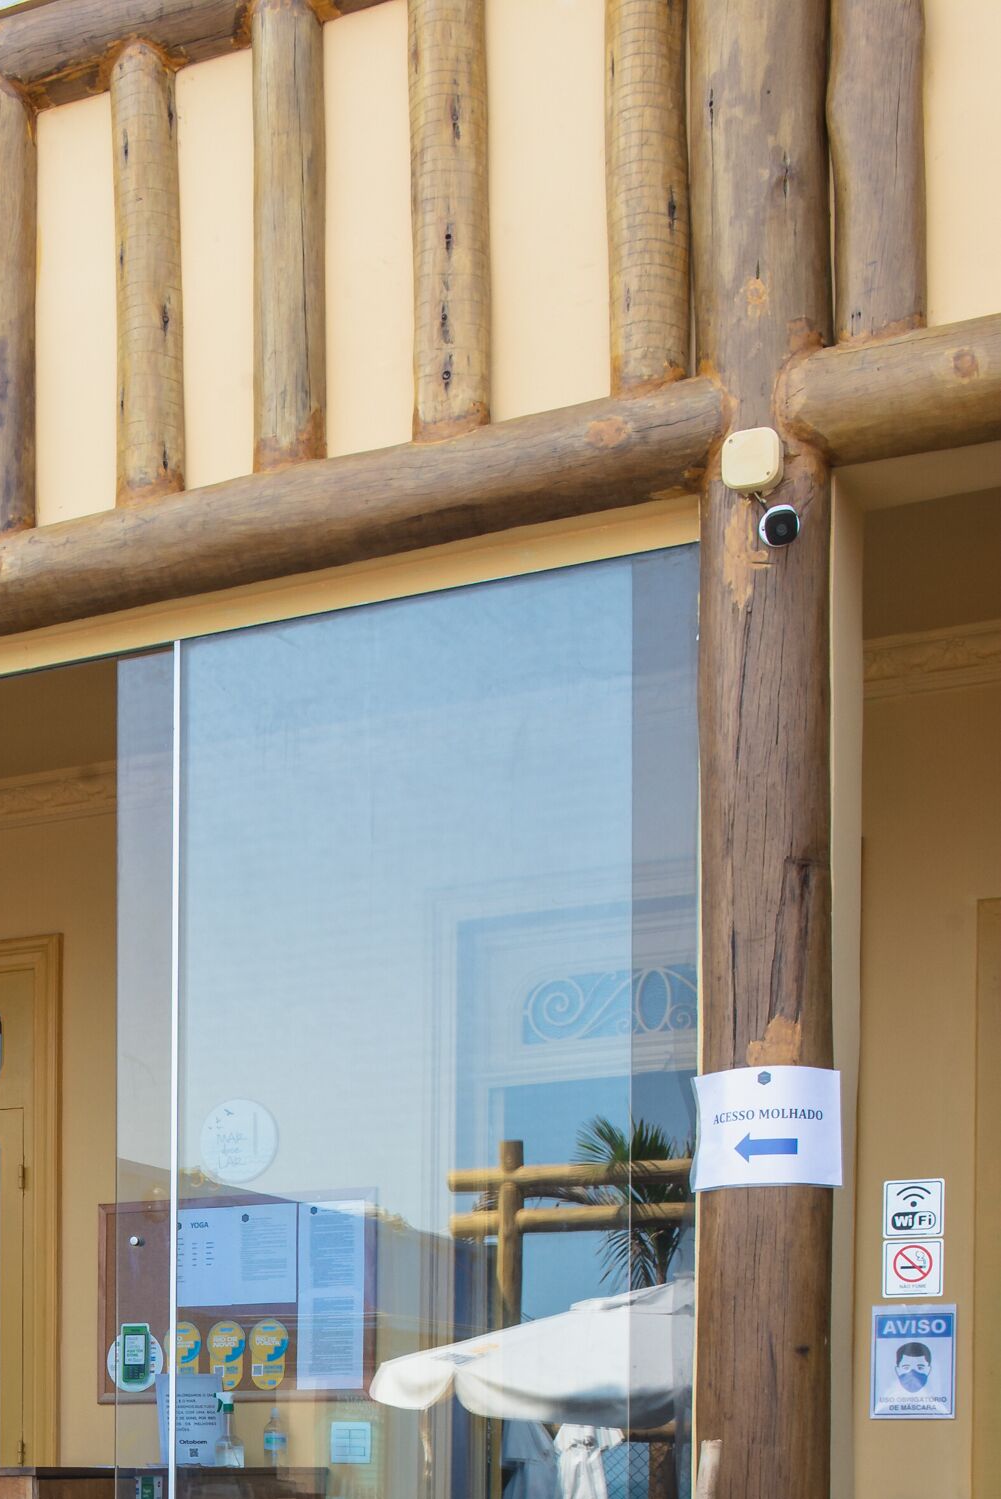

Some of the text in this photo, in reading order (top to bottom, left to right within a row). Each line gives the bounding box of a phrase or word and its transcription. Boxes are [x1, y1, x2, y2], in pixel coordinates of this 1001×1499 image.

[713, 1108, 823, 1125] ACESSO MOLHADO
[190, 1221, 209, 1229] YOGA
[882, 1318, 947, 1335] AVISO
[900, 1403, 937, 1411] MÁSCARA
